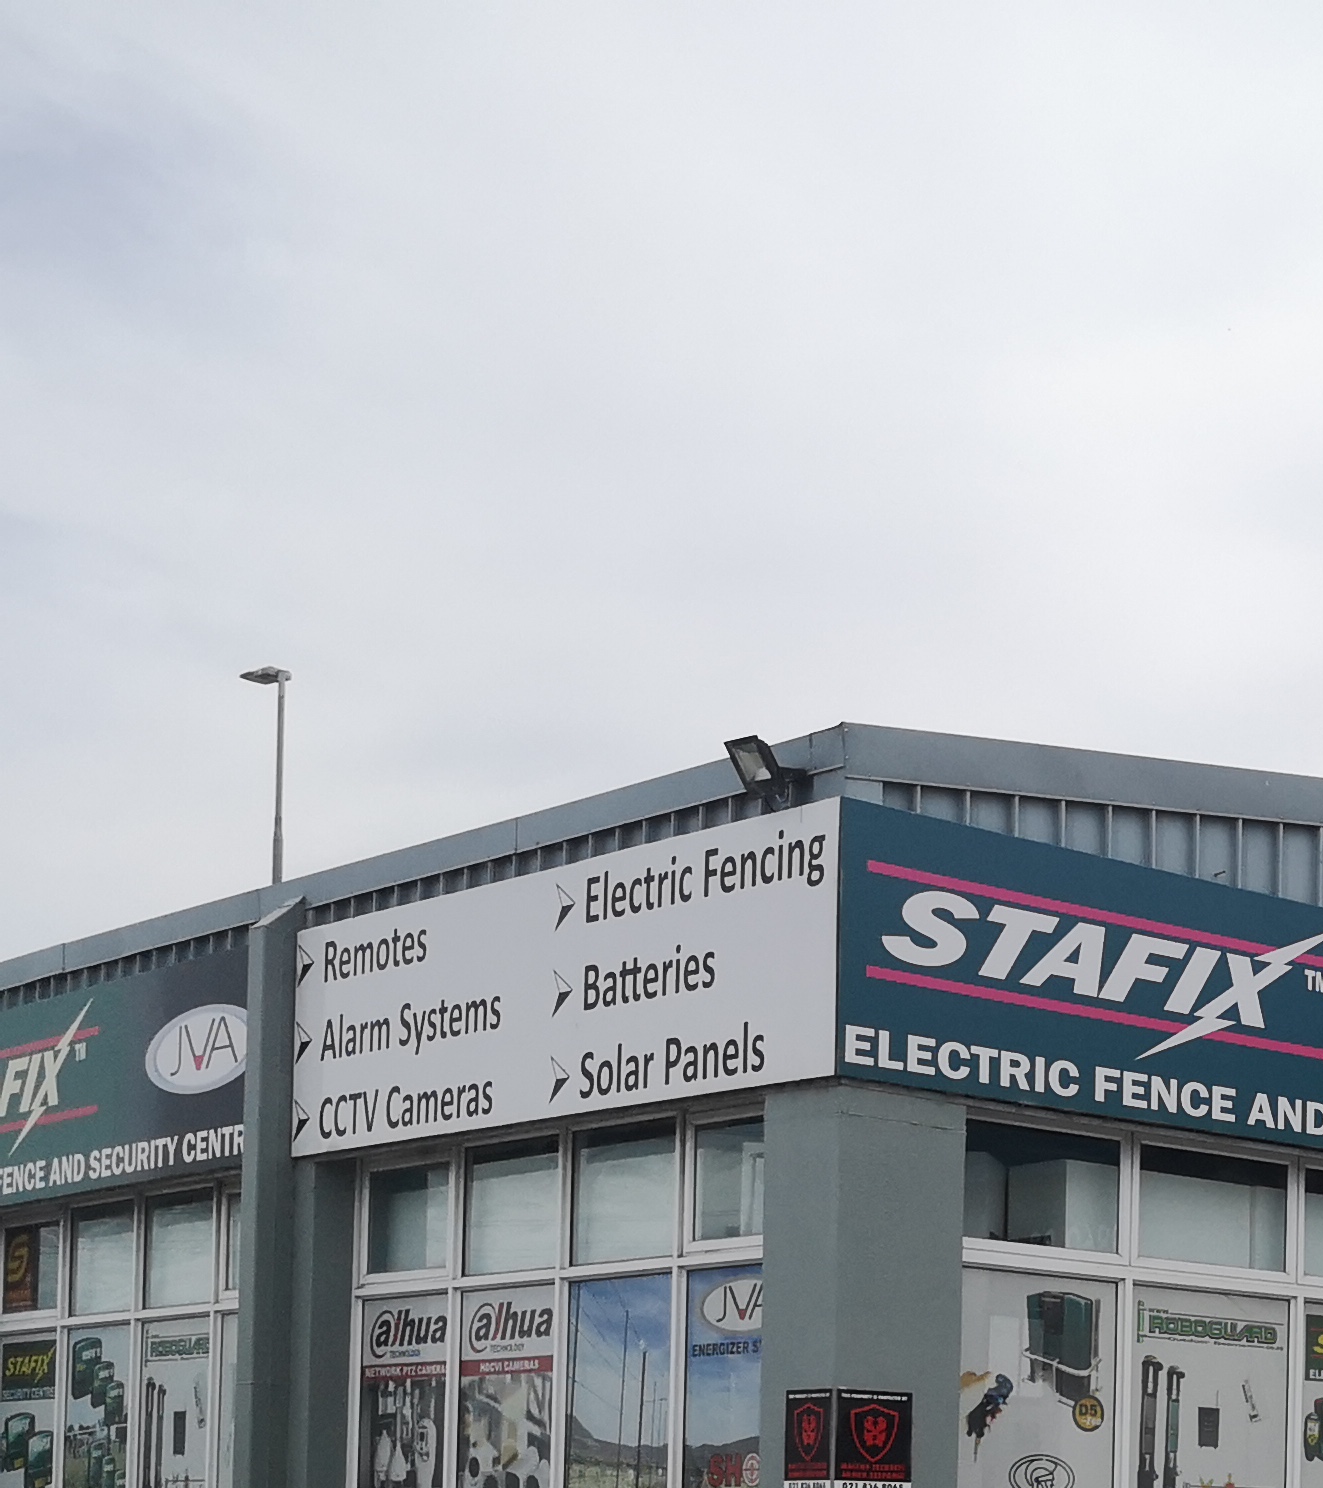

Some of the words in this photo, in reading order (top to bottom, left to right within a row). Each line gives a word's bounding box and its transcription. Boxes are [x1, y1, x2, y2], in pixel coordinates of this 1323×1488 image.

[585, 856, 693, 923] Electric
[702, 829, 827, 899] Fencing
[323, 927, 428, 983] Remotes
[583, 944, 716, 1011] Batteries
[882, 890, 1300, 1045] STAFIX
[170, 1015, 240, 1078] JVA
[320, 1013, 391, 1062] Alarm
[399, 995, 502, 1055] Systems
[580, 1043, 655, 1100] Solar
[665, 1022, 766, 1084] Panels
[844, 1024, 1080, 1097] ELECTRIC
[1094, 1066, 1237, 1124] FENCE
[319, 1088, 380, 1140] CCTV
[386, 1080, 494, 1130] Cameras
[0, 1160, 46, 1196] ENCE
[49, 1153, 86, 1187] AND
[89, 1135, 179, 1180] SECURITY
[691, 1341, 749, 1357] ENERGIZER
[1148, 1314, 1278, 1345] ROBOGUARD
[5, 1350, 54, 1381] STAFIX
[365, 1366, 401, 1378] NETWORK
[402, 1365, 417, 1376] PTZ
[503, 1359, 540, 1372] CAMERAS
[1078, 1403, 1098, 1417] D5
